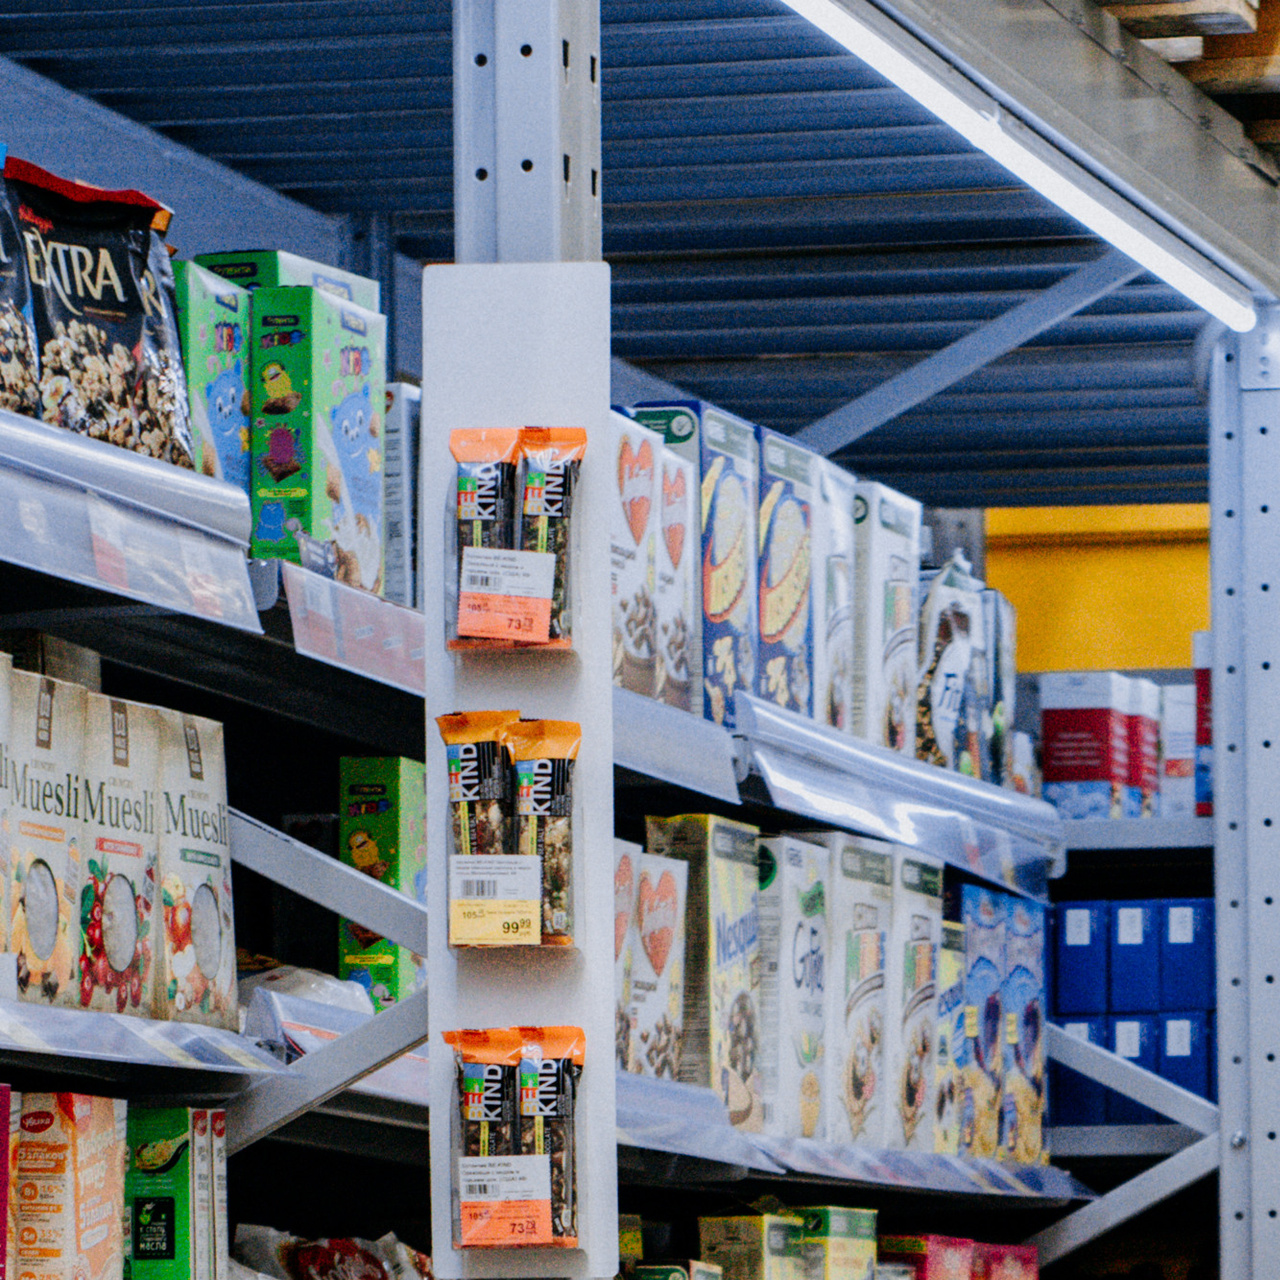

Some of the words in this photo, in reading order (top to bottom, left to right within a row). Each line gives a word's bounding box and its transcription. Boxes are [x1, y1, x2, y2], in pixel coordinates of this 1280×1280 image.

[23, 227, 127, 317] EXTRA
[11, 759, 79, 819] Muesli
[460, 743, 480, 800] KIND
[532, 758, 553, 816] KIND
[83, 777, 154, 834] Muesli
[163, 791, 228, 846] Muesli
[502, 921, 520, 934] 99
[483, 1064, 502, 1121] KIND
[537, 1058, 557, 1116] KIND
[489, 1131, 497, 1156] COLATE
[544, 1127, 552, 1154] OCOLATE
[510, 1223, 525, 1234] 73
